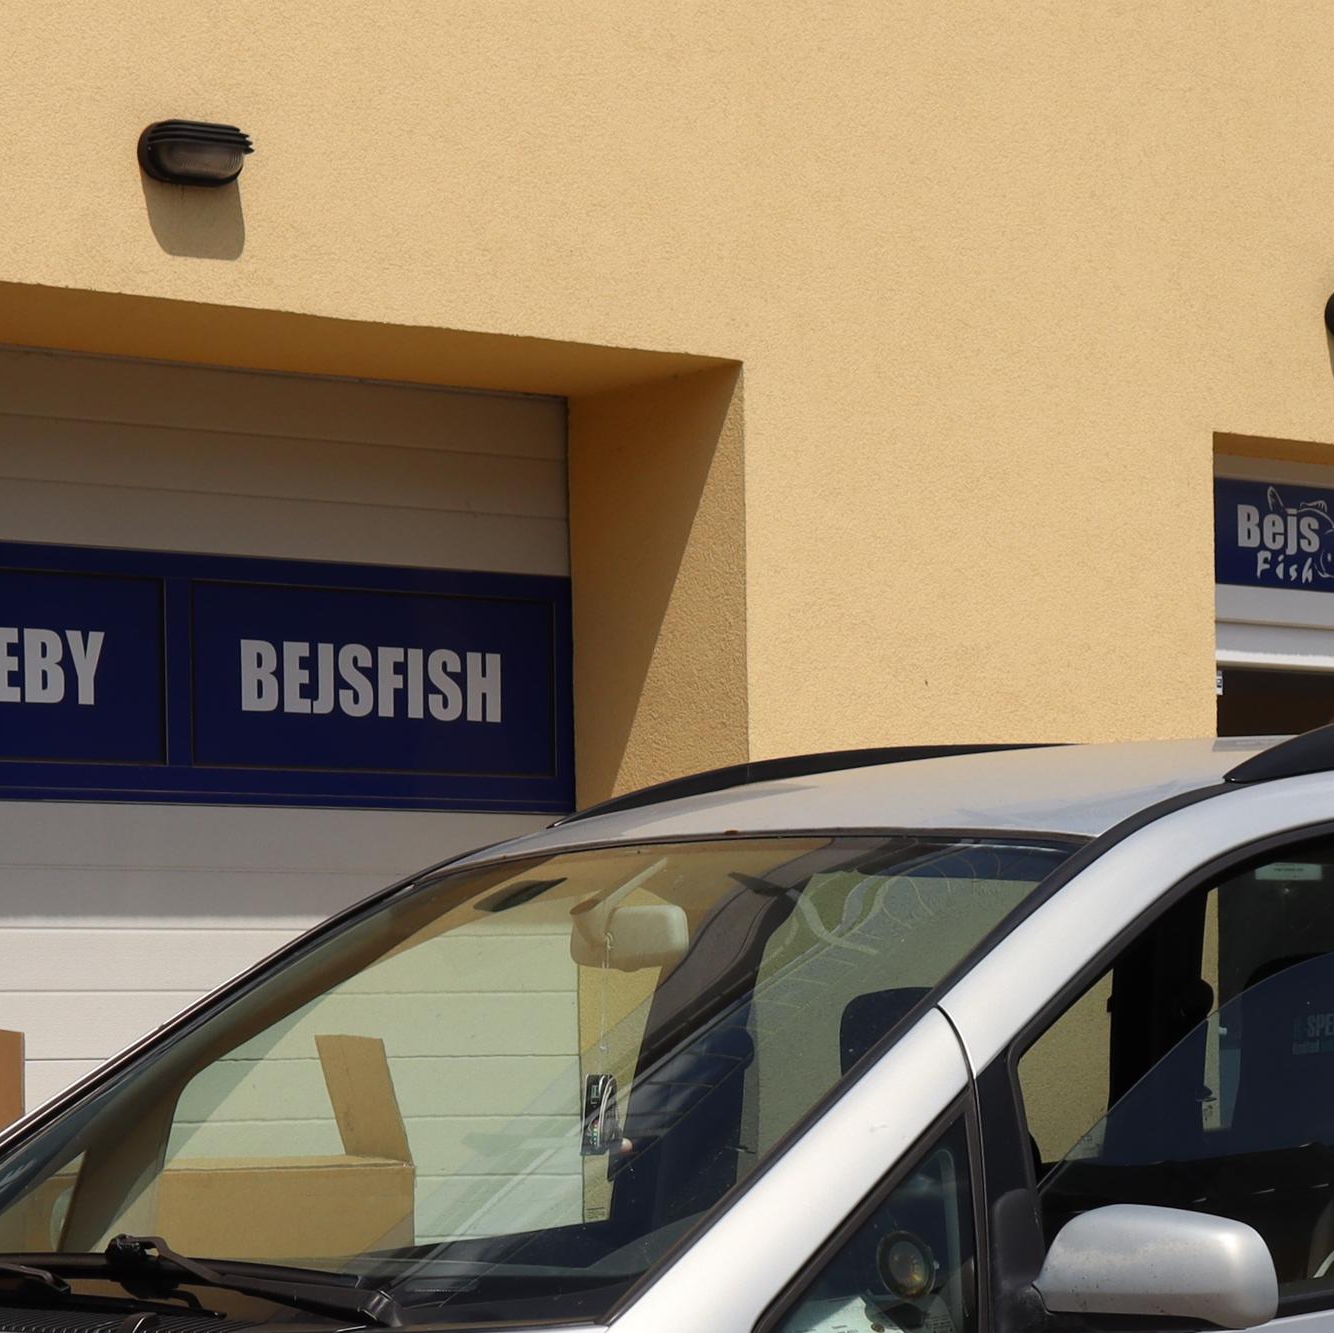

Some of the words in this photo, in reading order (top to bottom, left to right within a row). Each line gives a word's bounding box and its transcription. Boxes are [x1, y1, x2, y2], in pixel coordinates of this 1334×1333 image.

[1237, 504, 1320, 555] Bejs
[1256, 551, 1314, 583] Fish
[239, 638, 503, 724] BEJSFISH
